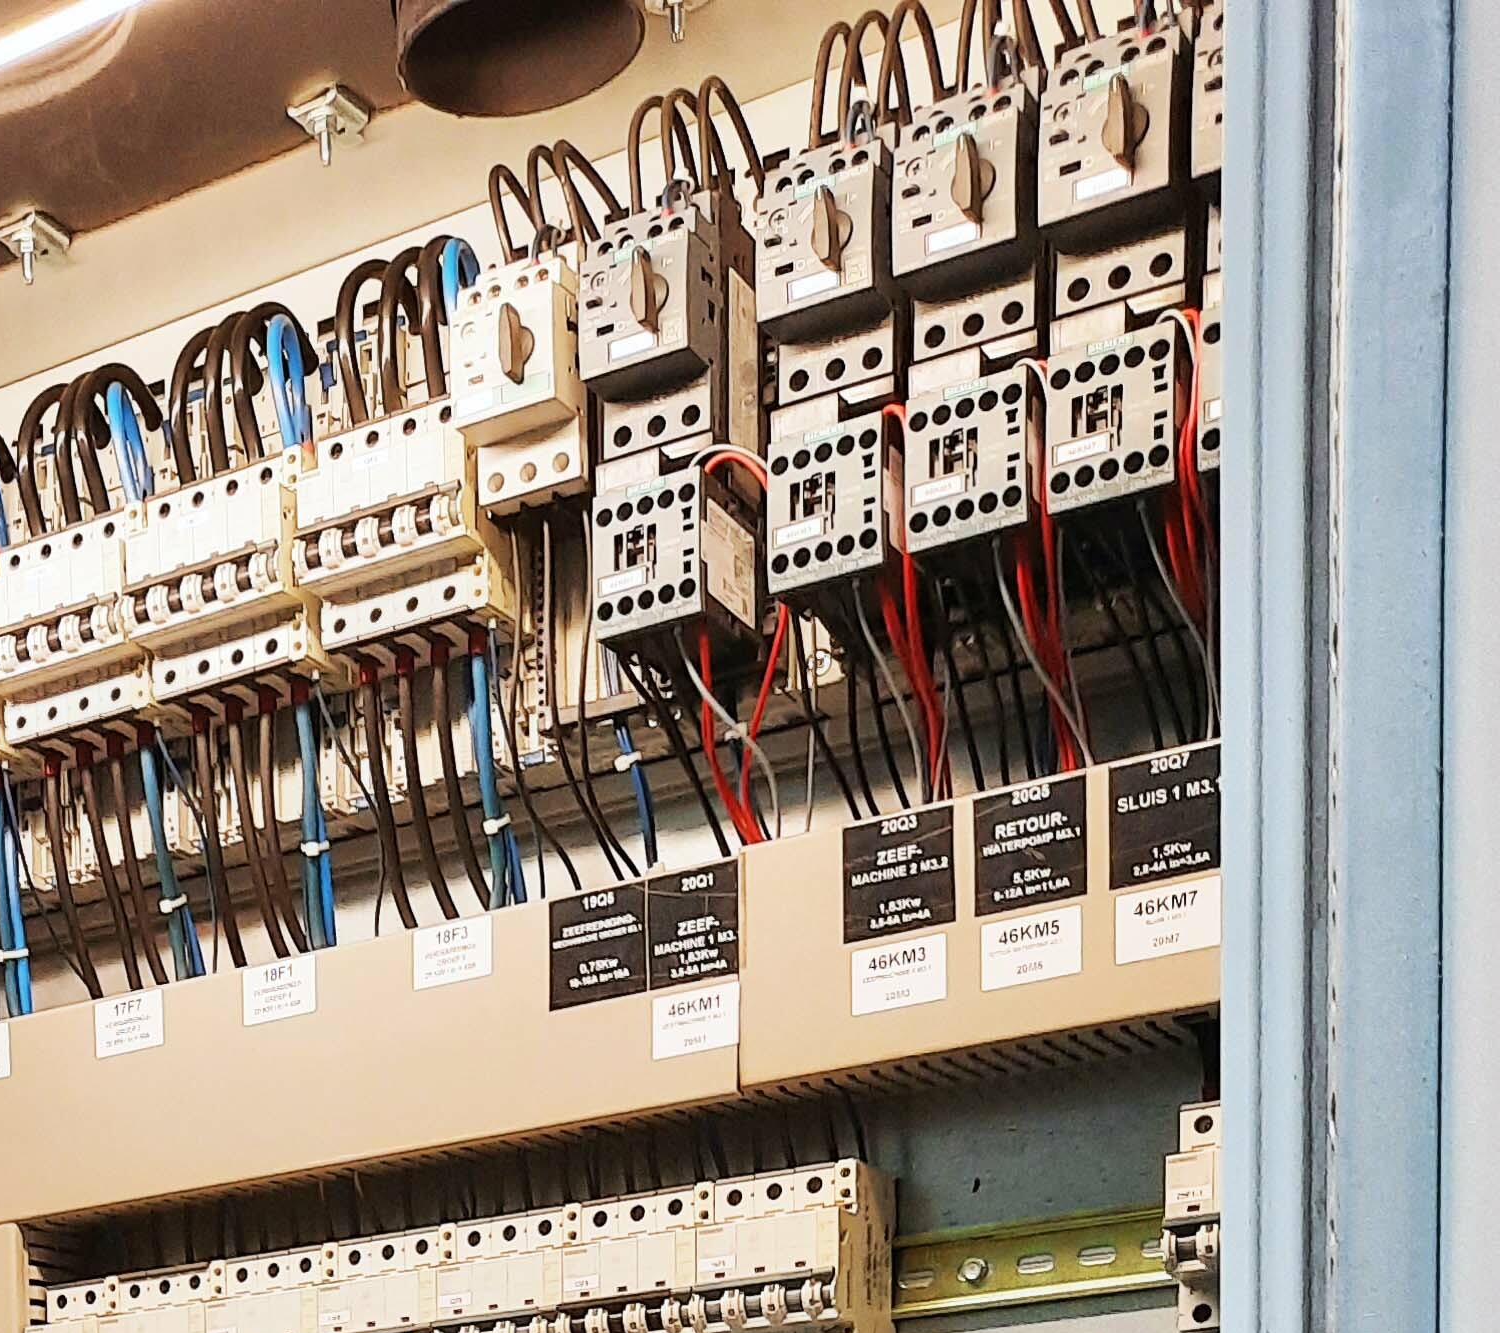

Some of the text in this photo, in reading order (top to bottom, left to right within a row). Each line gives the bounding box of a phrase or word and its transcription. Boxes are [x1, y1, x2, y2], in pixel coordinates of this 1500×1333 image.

[1150, 752, 1190, 775] 20Q7
[1117, 789, 1167, 813] SLUIS
[1172, 785, 1180, 800] 1
[880, 814, 918, 836] 20Q3
[995, 811, 1068, 841] RETOUR-
[876, 844, 923, 867] ZEEF-
[982, 831, 1054, 858] WATERPOMP
[681, 872, 714, 892] 20Q1
[851, 866, 907, 888] MACHINE
[909, 863, 918, 875] 2
[1133, 890, 1198, 917] 46KM7
[435, 926, 469, 945] 18F3
[677, 915, 720, 937] ZEEF-
[998, 919, 1060, 945] 46KM5
[654, 936, 706, 956] MACHINE
[868, 946, 928, 971] 46KM3
[263, 963, 294, 983] 18F1
[113, 998, 143, 1017] 17F7
[668, 994, 721, 1017] 46KM1
